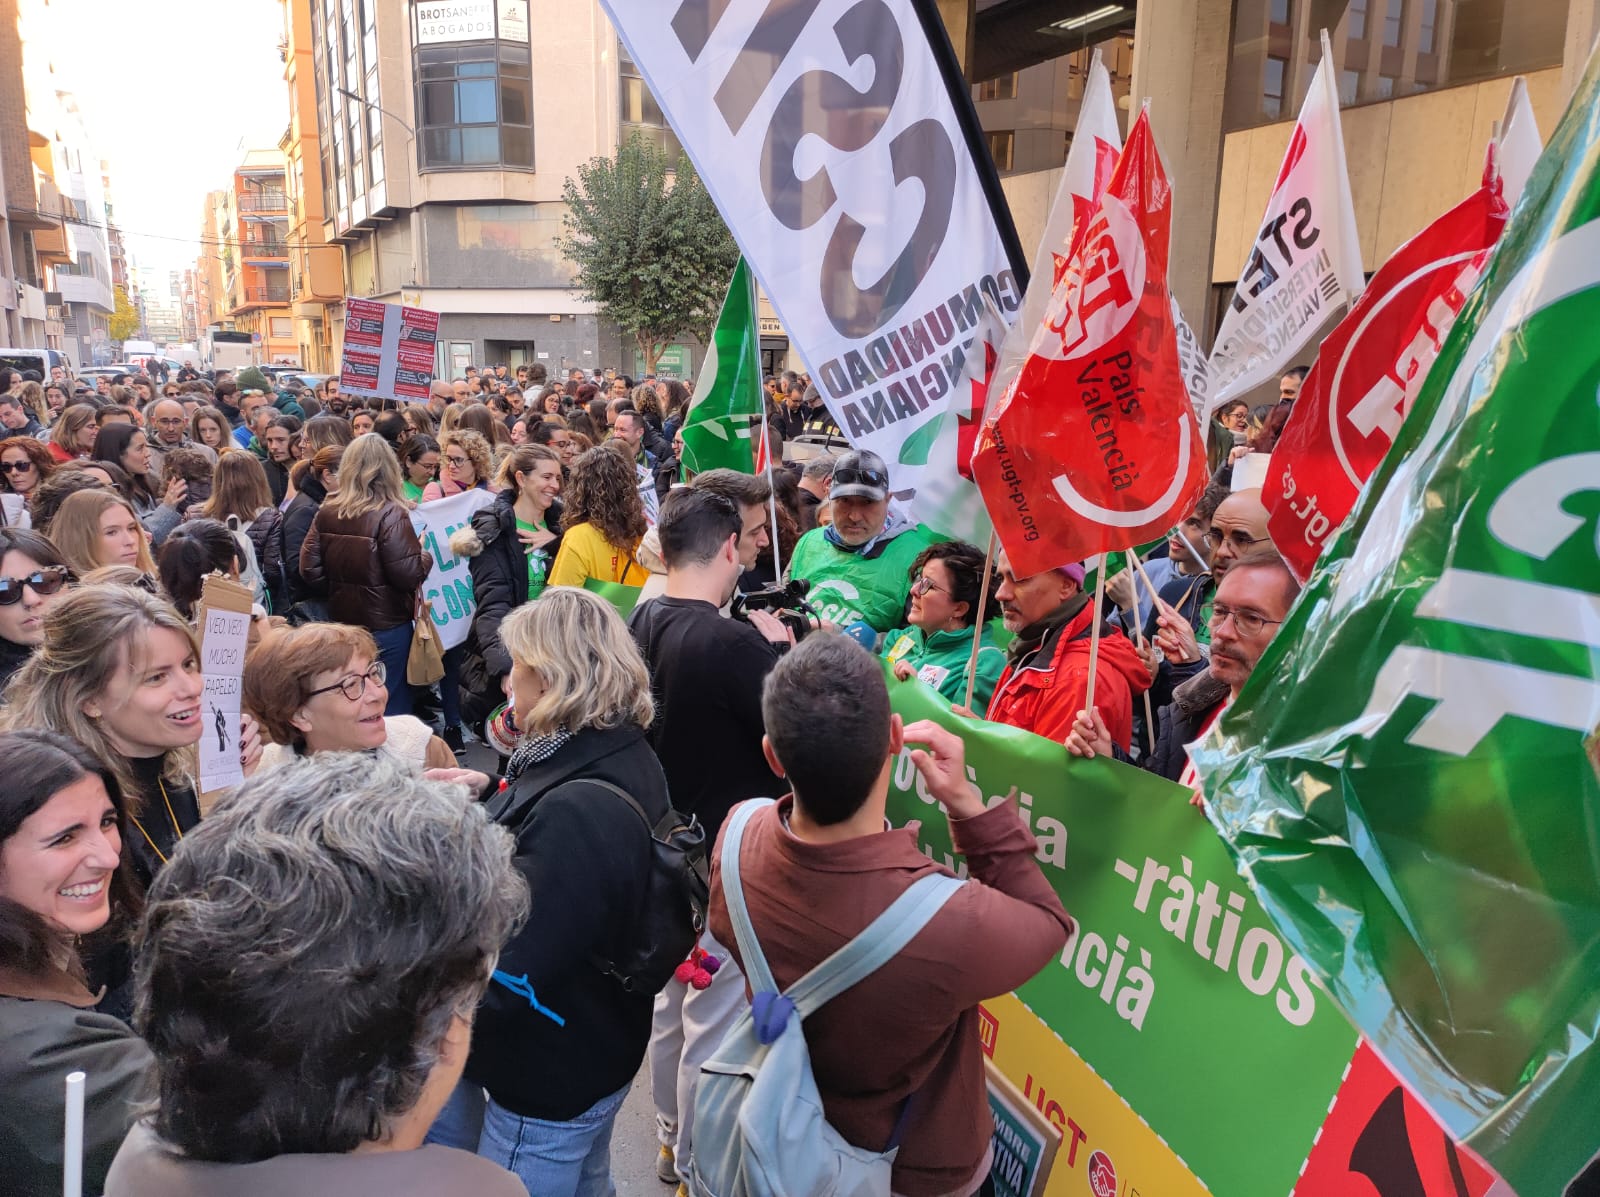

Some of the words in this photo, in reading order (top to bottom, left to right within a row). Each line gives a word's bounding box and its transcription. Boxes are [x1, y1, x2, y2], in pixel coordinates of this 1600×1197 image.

[422, 21, 492, 36] ABOGADOS
[1103, 351, 1145, 415] País
[1076, 361, 1140, 491] Valencià
[208, 648, 238, 665] MUCHO
[205, 678, 238, 696] PAPELEO
[1114, 855, 1320, 1026] -ràtios
[991, 1108, 1031, 1163] MBRE
[992, 1135, 1023, 1194] TIVA
